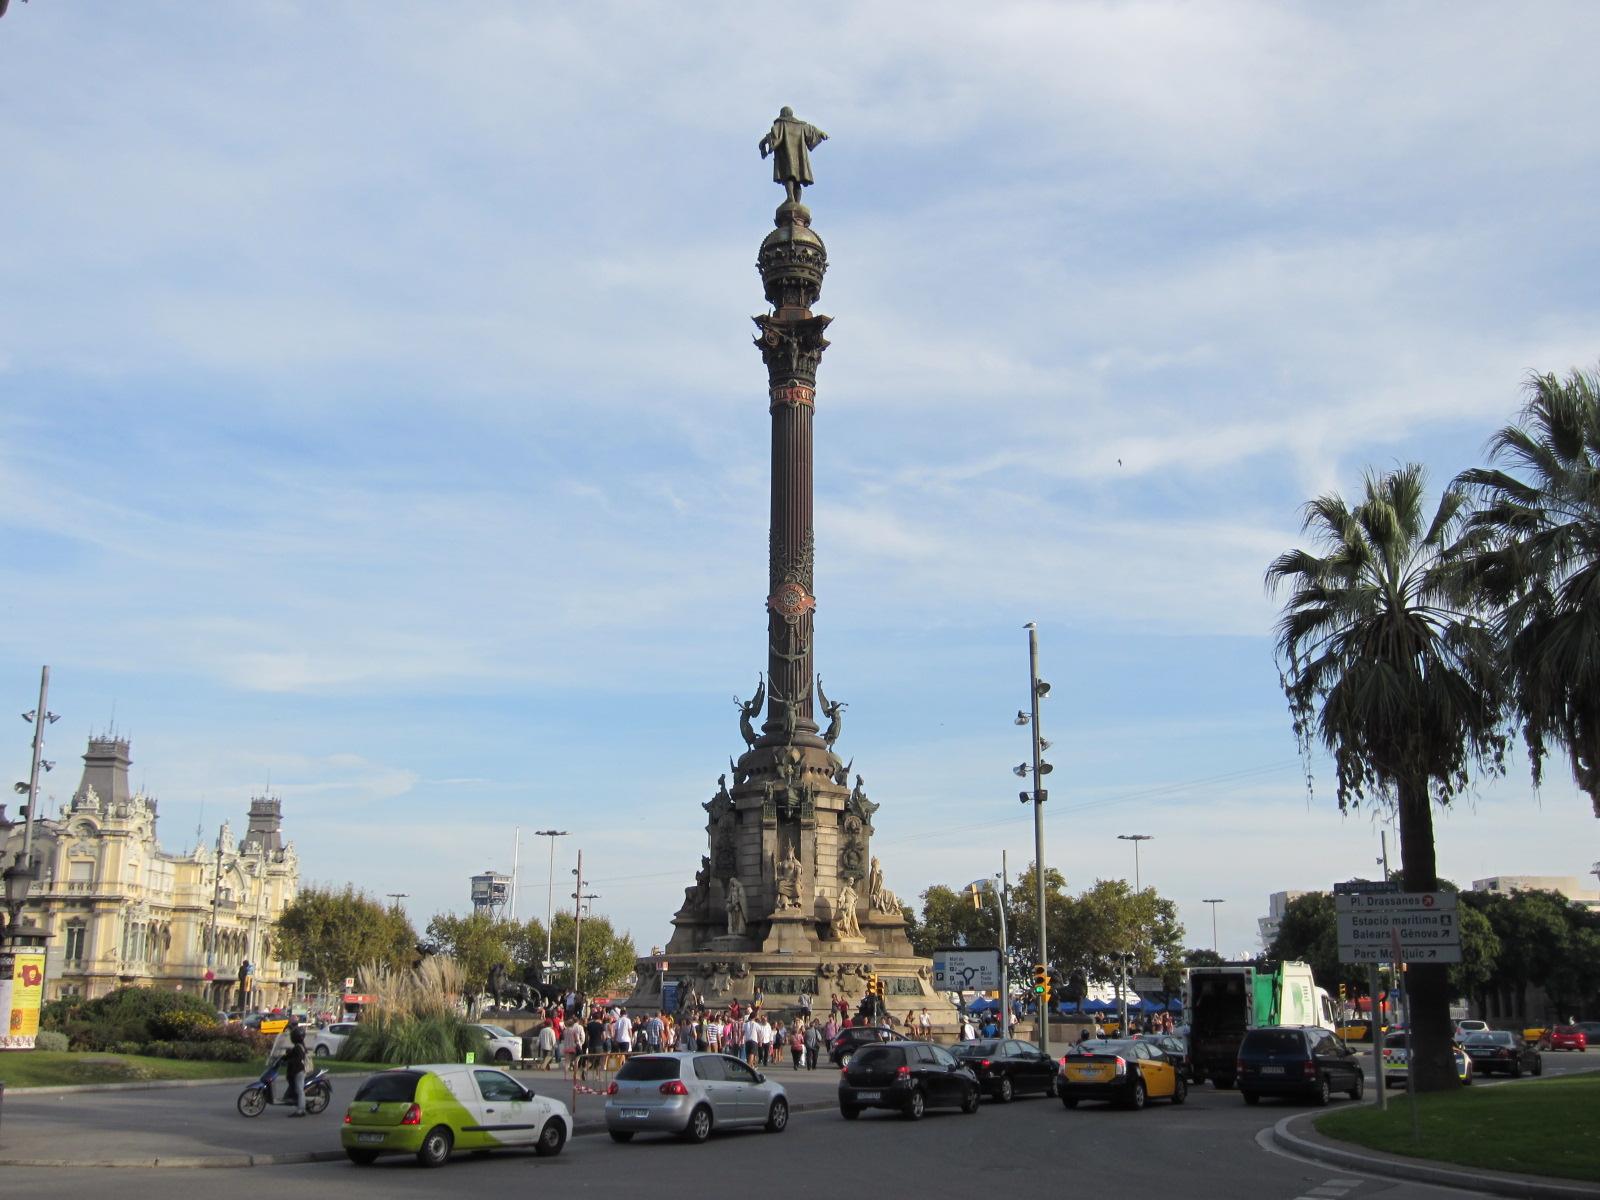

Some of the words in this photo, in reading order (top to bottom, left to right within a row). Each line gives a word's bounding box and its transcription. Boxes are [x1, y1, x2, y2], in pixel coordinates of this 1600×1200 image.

[1351, 897, 1364, 907] Pl.
[1367, 895, 1420, 906] Drassanes
[1352, 914, 1389, 926] Estació
[1392, 913, 1438, 925] marítima
[1352, 928, 1391, 939] Balears
[1354, 949, 1376, 959] Parc
[1380, 948, 1425, 960] Motjuïc
